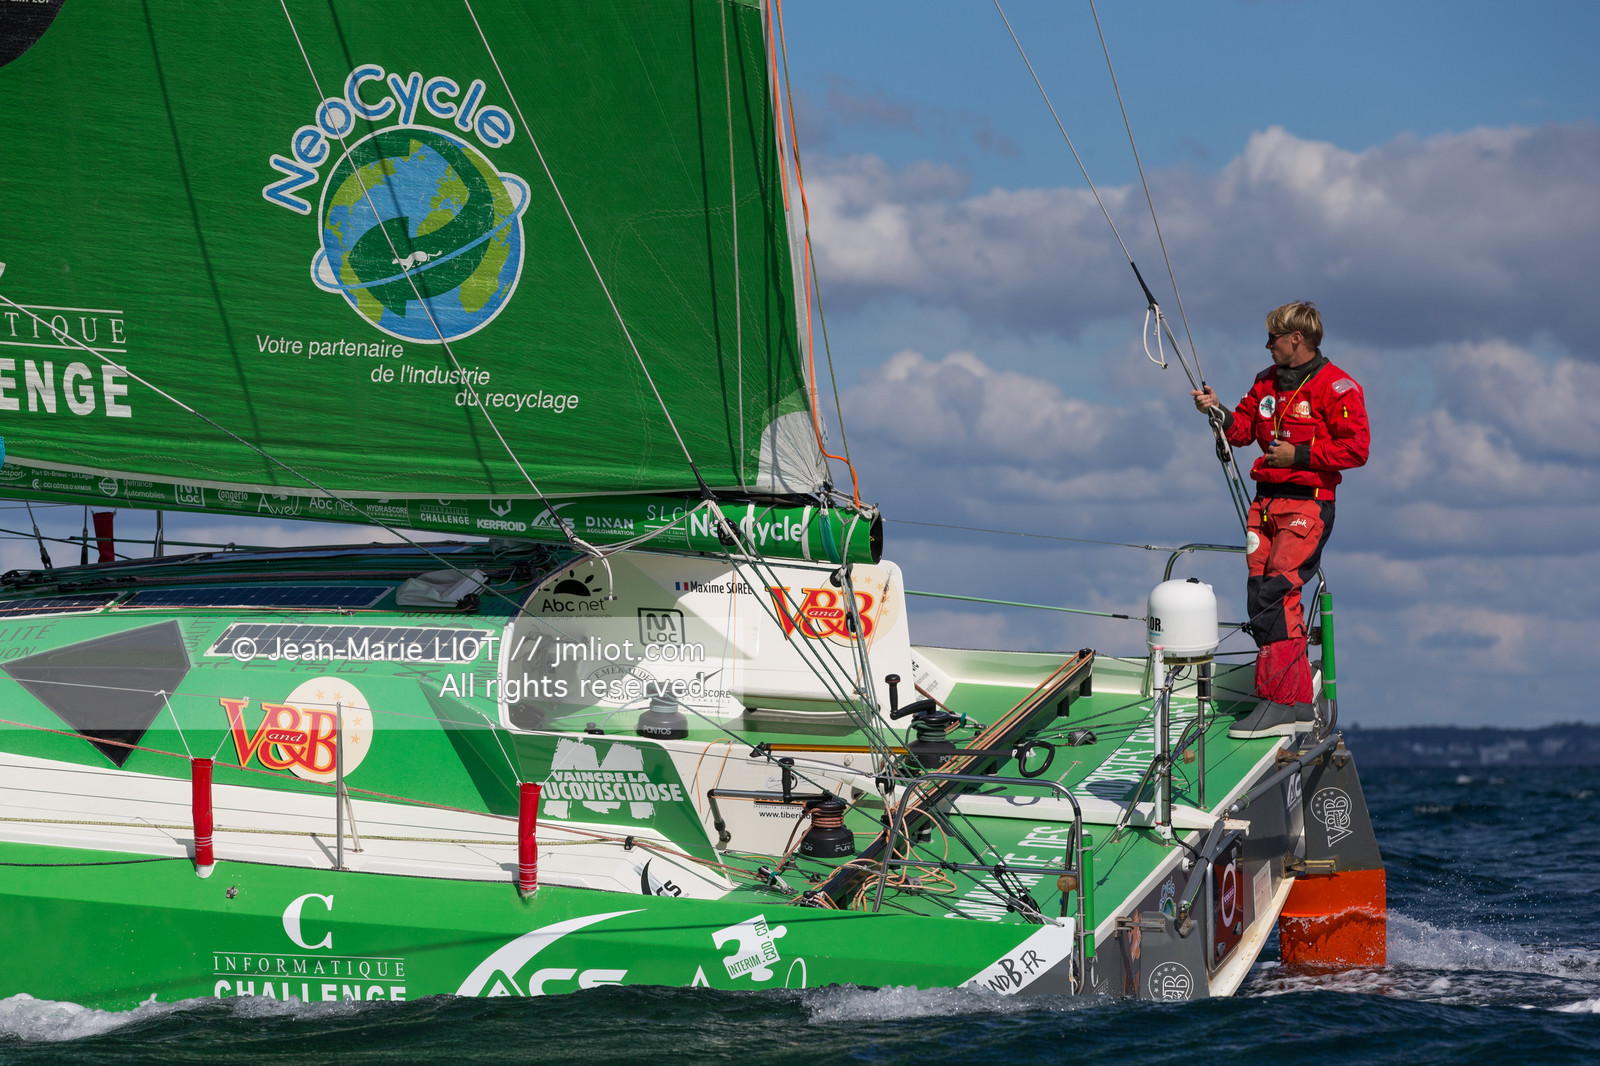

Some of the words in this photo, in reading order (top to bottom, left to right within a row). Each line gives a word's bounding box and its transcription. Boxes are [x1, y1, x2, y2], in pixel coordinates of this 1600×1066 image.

[261, 63, 516, 216] NeoCycle
[4, 312, 128, 348] TIQUE
[256, 334, 303, 355] Votre
[308, 337, 404, 359] partenaire
[370, 364, 395, 383] de
[400, 364, 491, 385] l'industrie
[455, 389, 479, 407] du
[485, 389, 580, 413] recyclage
[309, 496, 333, 511] Abc
[420, 513, 470, 526] CHALLENGE
[476, 518, 527, 532] KERFROID
[585, 515, 635, 531] DINAN
[690, 513, 803, 547] NeCycle
[690, 580, 725, 594] Maxime
[541, 598, 574, 613] Abc
[578, 598, 606, 612] net
[642, 724, 673, 736] PONTOS
[551, 771, 625, 783] VAINCRE
[627, 772, 651, 784] LA
[537, 781, 684, 802] UCOVISCIDOSE
[282, 893, 334, 949] C
[213, 955, 406, 980] INFORMATIQUE
[727, 954, 762, 976] INTERIM
